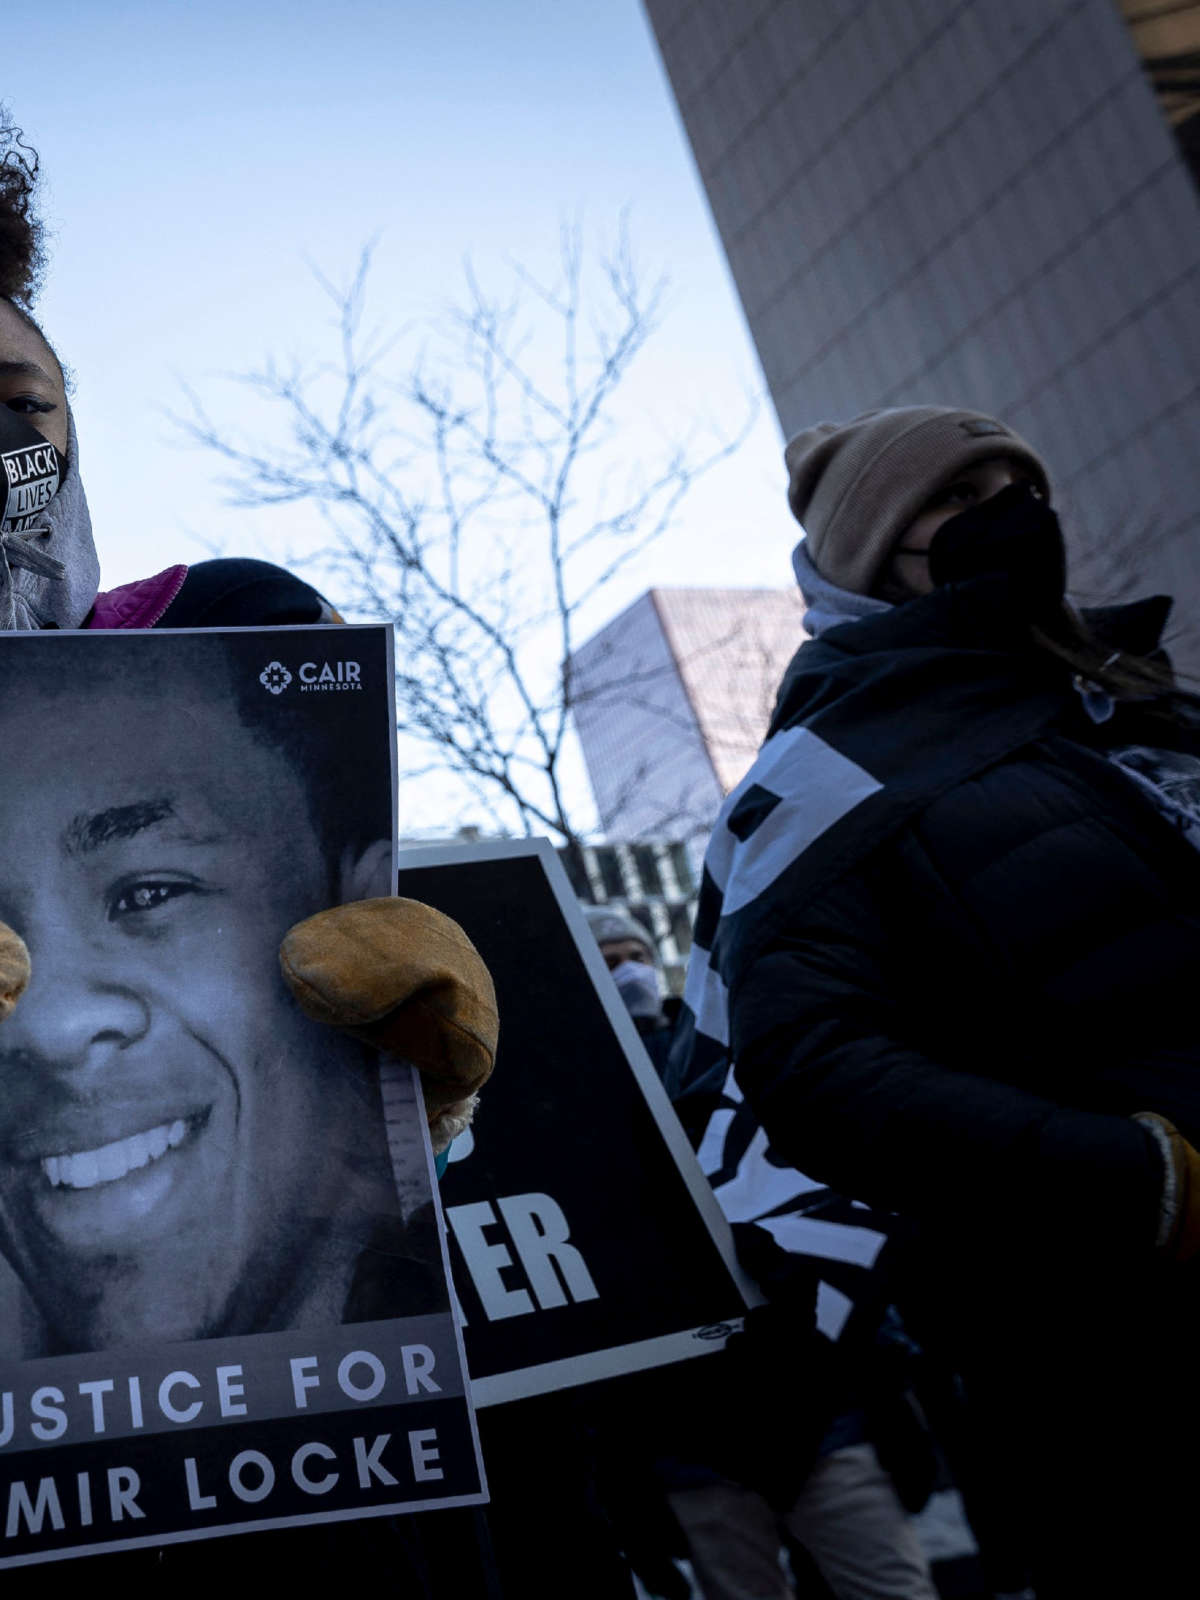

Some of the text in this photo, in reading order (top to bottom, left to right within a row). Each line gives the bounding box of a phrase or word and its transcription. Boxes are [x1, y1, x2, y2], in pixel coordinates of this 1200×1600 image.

[6, 448, 56, 483] BLACK
[17, 481, 52, 512] LIVES
[299, 661, 361, 683] CAIR
[301, 682, 362, 692] MINNESOTA
[444, 1192, 600, 1327] ER
[290, 1343, 442, 1408] FOR
[185, 1428, 444, 1511] LOCKE
